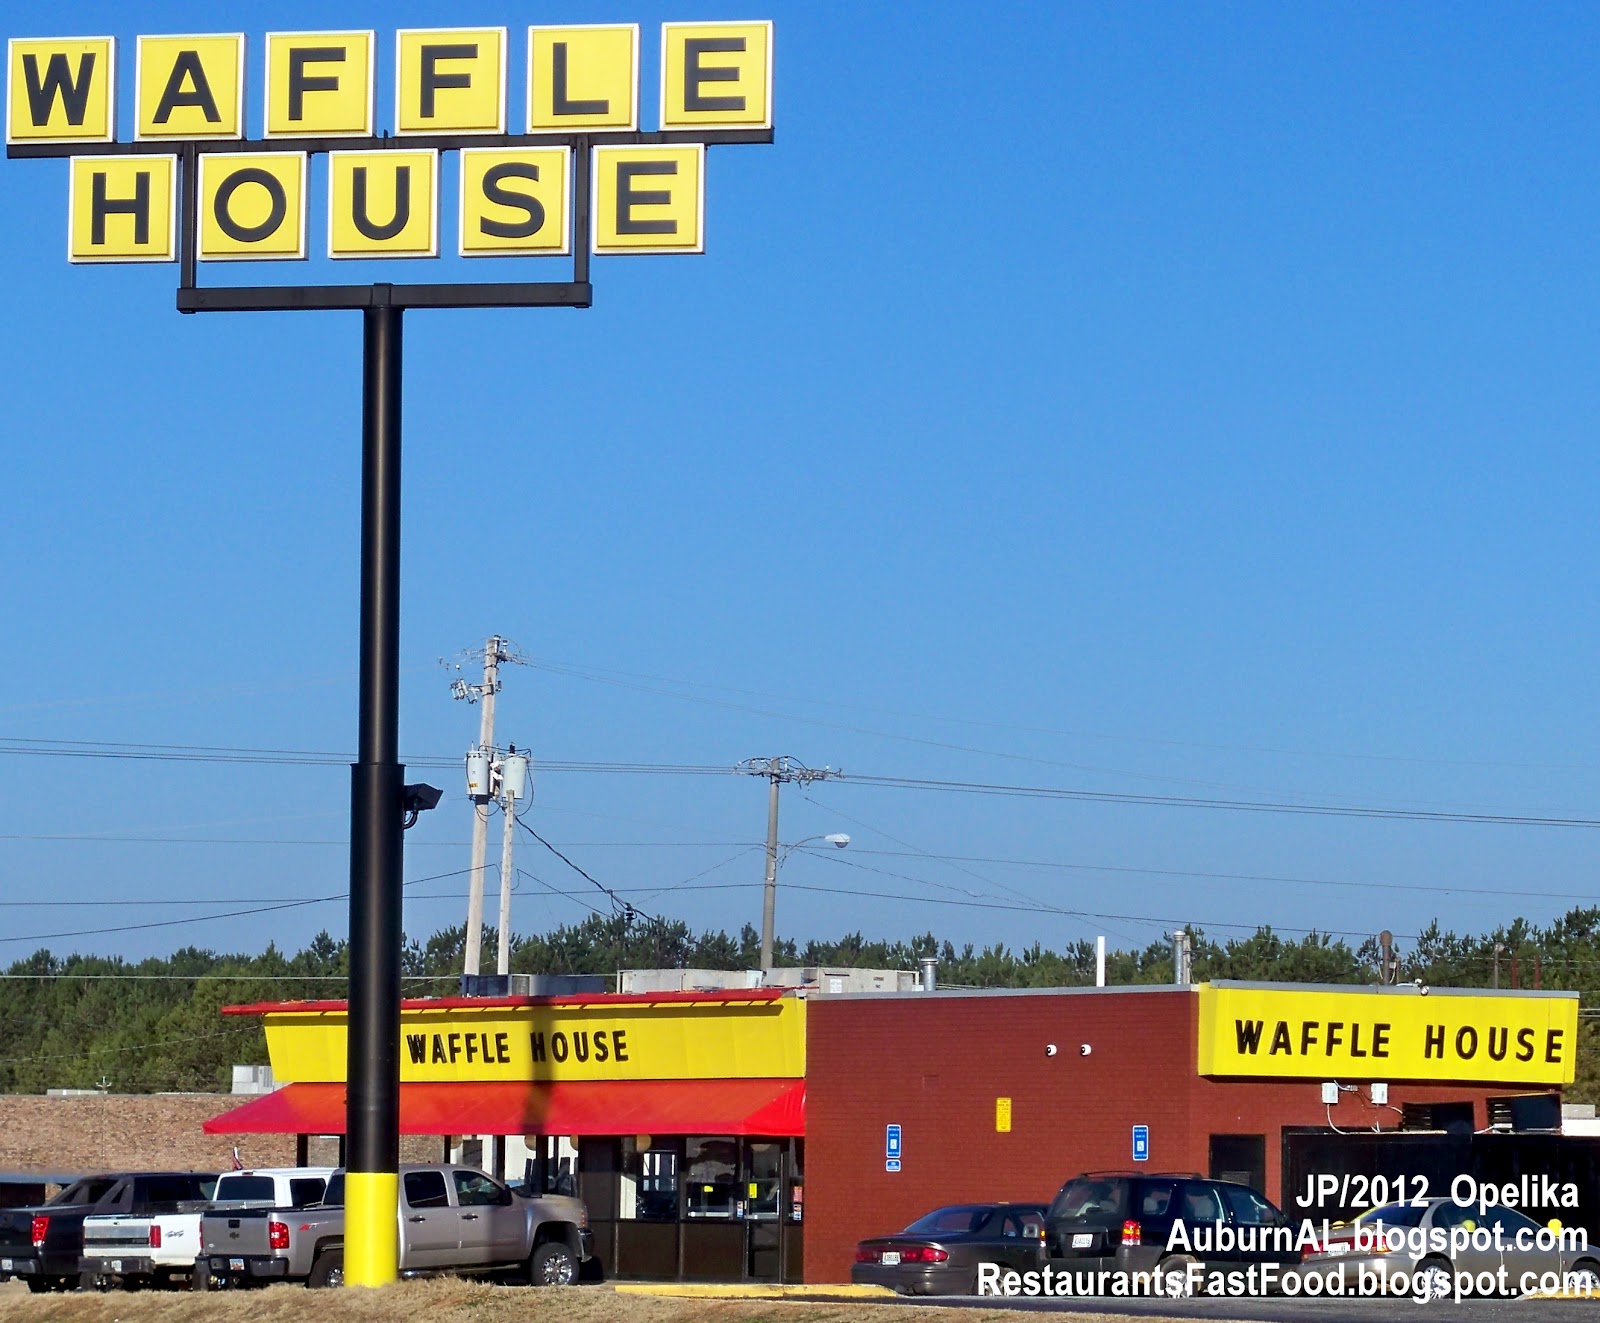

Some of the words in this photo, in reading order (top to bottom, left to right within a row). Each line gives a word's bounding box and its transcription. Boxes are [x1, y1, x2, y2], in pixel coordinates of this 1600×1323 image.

[22, 37, 747, 127] WAFFLE
[91, 160, 678, 245] HOUSE
[406, 1032, 511, 1064] WAFFLE
[530, 1029, 629, 1063] HOUSE
[1235, 1019, 1391, 1058] WAFFLE
[1424, 1024, 1564, 1063] HOUSE
